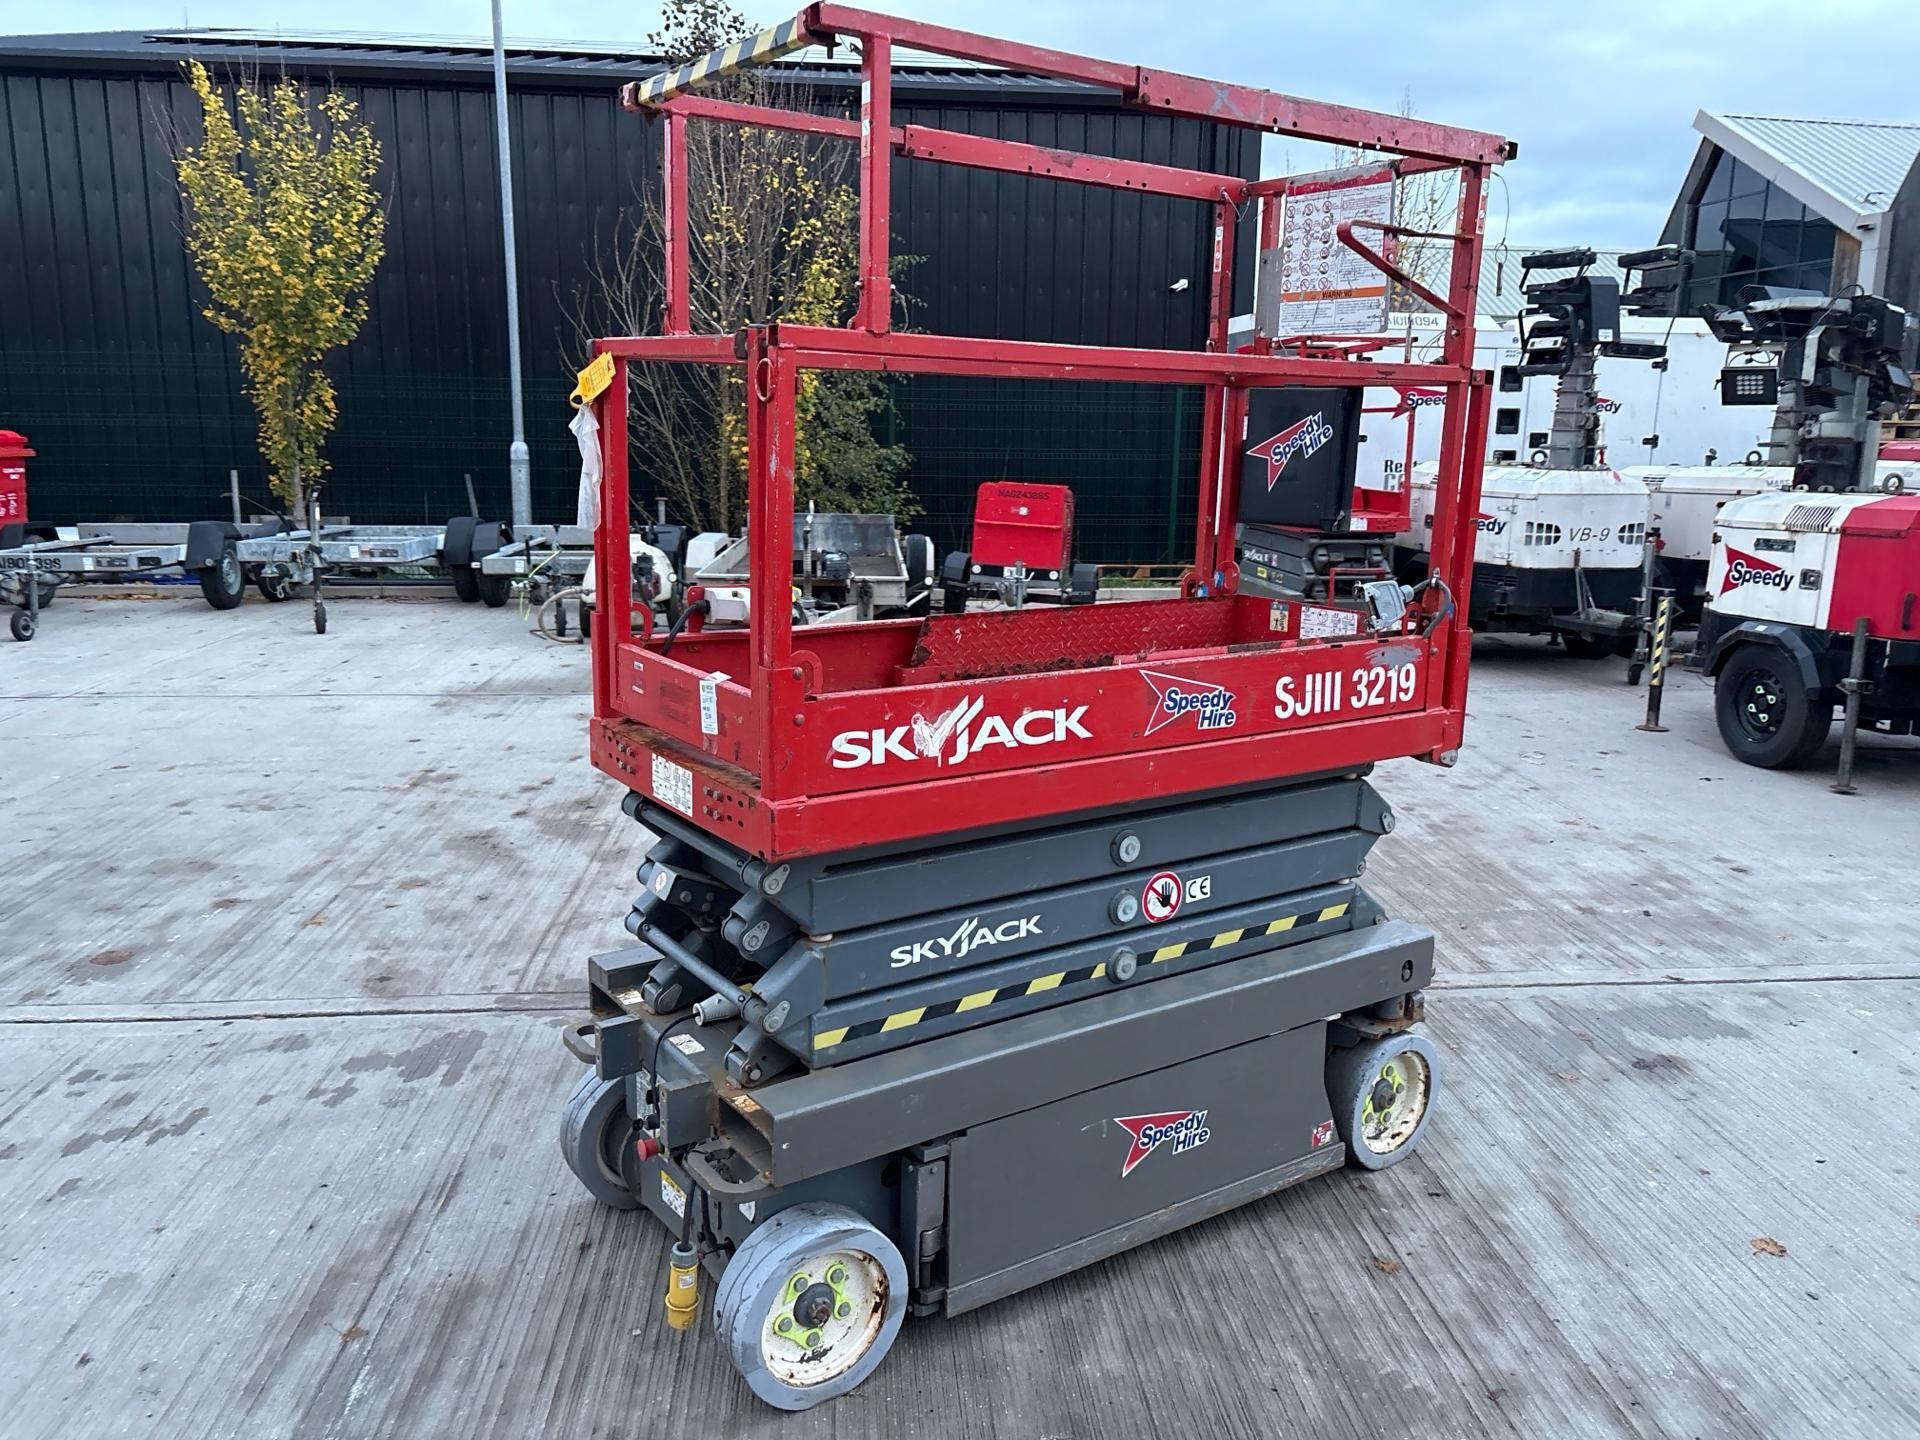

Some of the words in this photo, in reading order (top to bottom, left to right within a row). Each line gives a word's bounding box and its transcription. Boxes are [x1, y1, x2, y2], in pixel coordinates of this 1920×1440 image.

[1407, 393, 1447, 410] Spee
[1595, 401, 1622, 414] edy
[1271, 415, 1322, 463] Speedy
[1302, 426, 1332, 456] Hire
[1477, 518, 1506, 535] edy
[1568, 528, 1611, 542] VB-9
[1731, 562, 1795, 591] Speedy
[1351, 663, 1416, 709] 3219
[1165, 688, 1234, 714] Speedy
[831, 695, 1094, 768] SKYJACK
[1200, 709, 1235, 728] Hire
[1188, 877, 1209, 899] CE
[891, 915, 1043, 968] SKYJACK
[1140, 1111, 1205, 1147] Speedy
[1174, 1128, 1209, 1153] Hire
